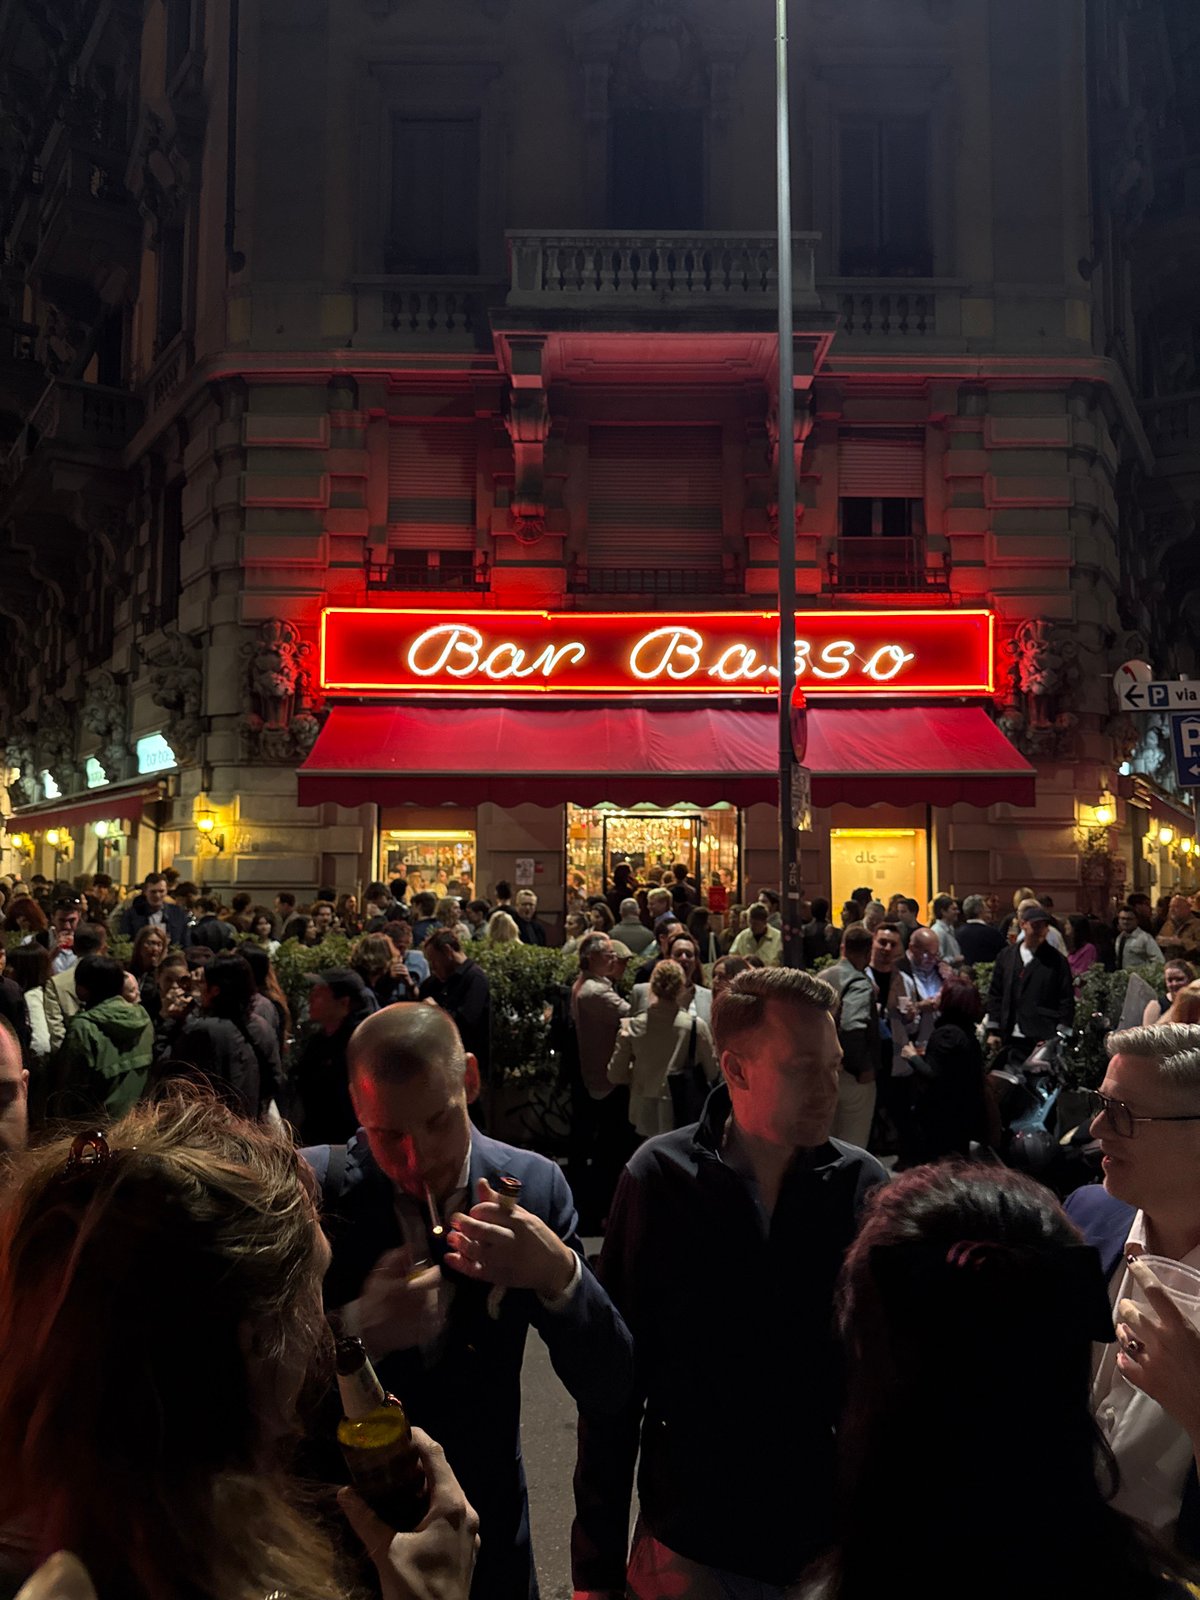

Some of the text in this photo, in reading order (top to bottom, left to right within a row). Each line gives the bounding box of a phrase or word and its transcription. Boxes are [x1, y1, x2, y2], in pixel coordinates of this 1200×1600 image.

[407, 623, 915, 680] Bar Basso
[1152, 687, 1198, 705] P via
